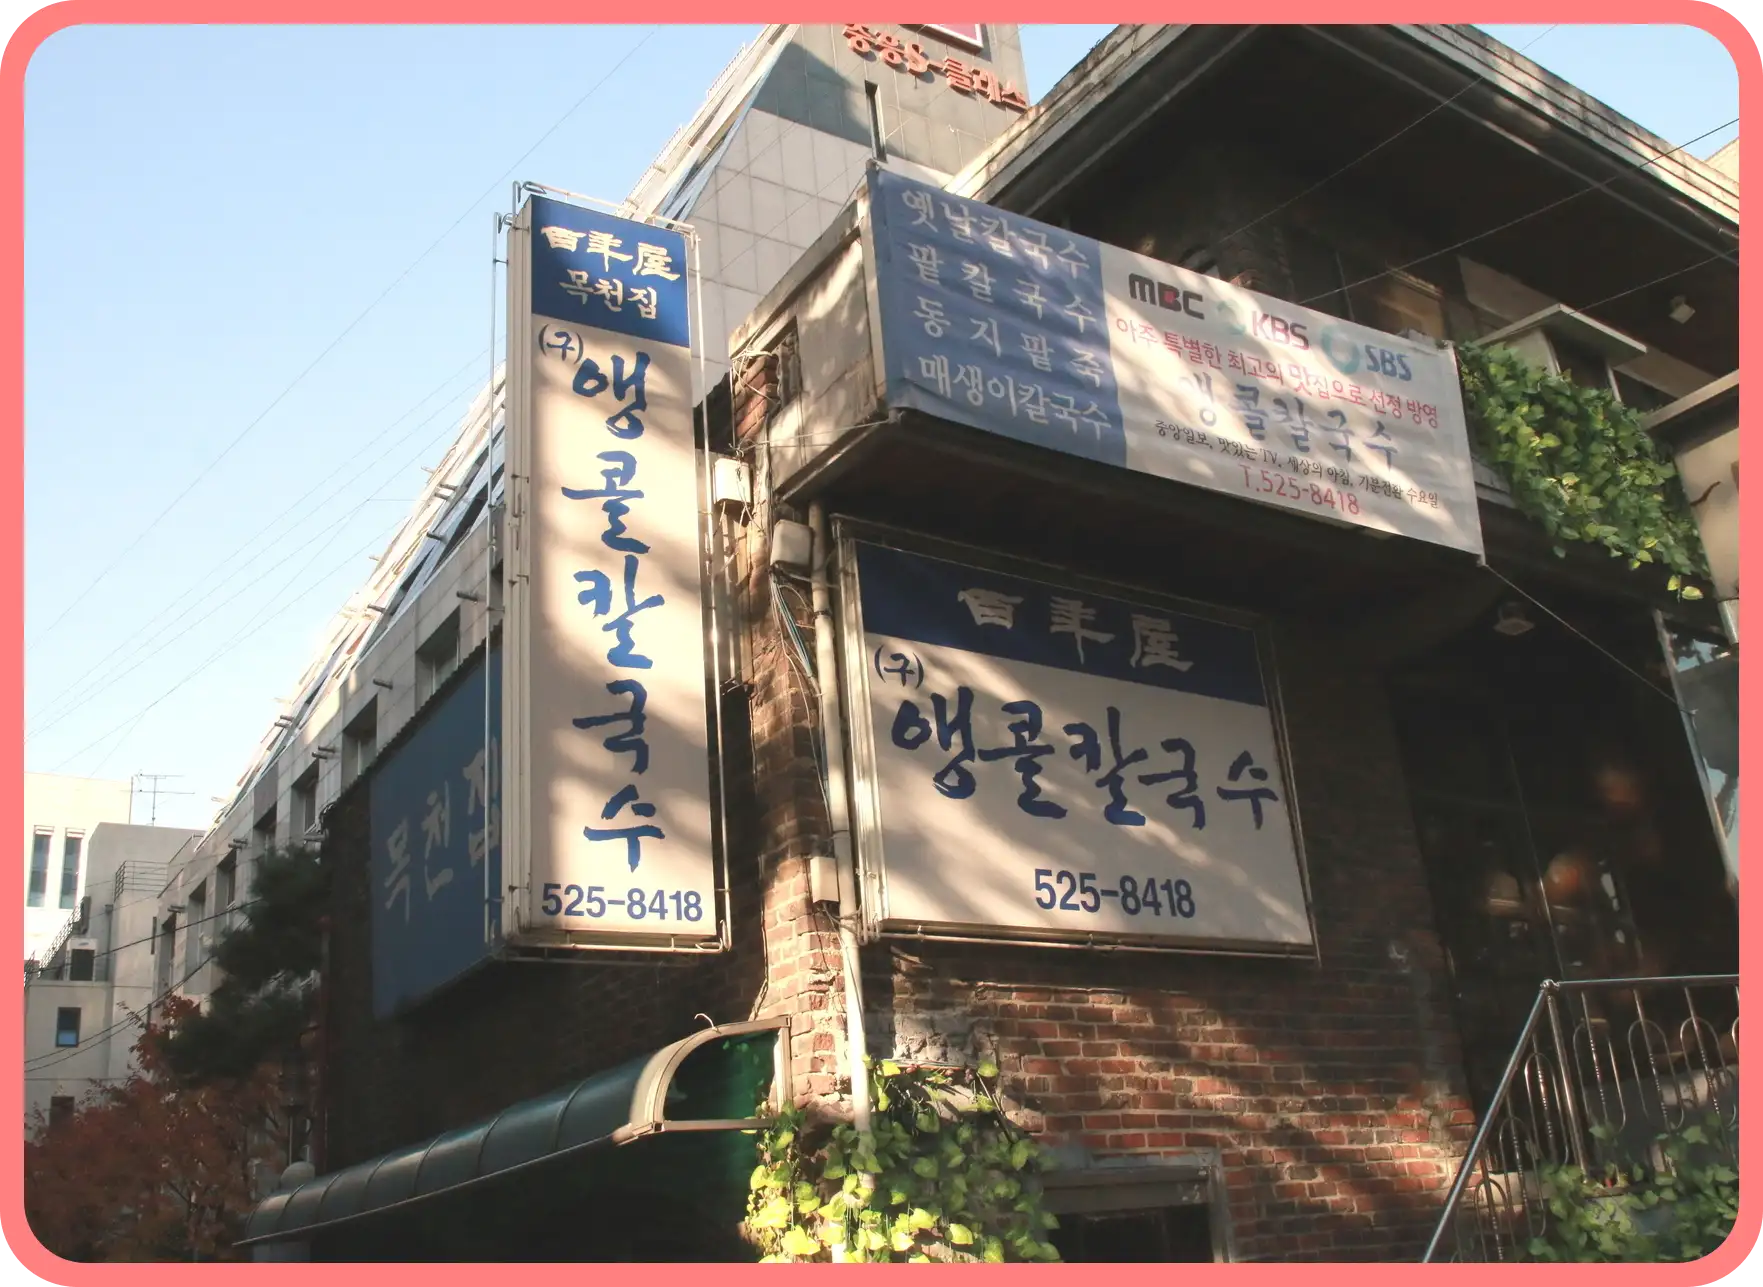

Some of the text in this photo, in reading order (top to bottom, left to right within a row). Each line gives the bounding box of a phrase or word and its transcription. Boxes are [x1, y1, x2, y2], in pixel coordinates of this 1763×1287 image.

[541, 226, 681, 281] 百年屋
[902, 190, 1090, 279] 옛날칼국수
[559, 269, 658, 320] 목천집
[1129, 273, 1412, 382] MBC KBS SBS
[538, 323, 584, 365] (구)
[1116, 318, 1438, 429] 아주 특별한 최고의 맛집으로 선정 방영
[918, 354, 1112, 440] 매생이칼국수
[1216, 437, 1258, 461] 맛있는
[1287, 456, 1322, 478] 세상의
[1358, 475, 1404, 500] 기분전환
[1406, 487, 1438, 509] 수요일
[561, 351, 666, 873] 앵콜칼국수
[957, 587, 1195, 672] 百年屋
[873, 644, 925, 689] (구)
[891, 686, 1280, 830] 앵콜칼국수
[541, 883, 704, 922] 525-8418
[1034, 868, 1196, 919] 525-8418
